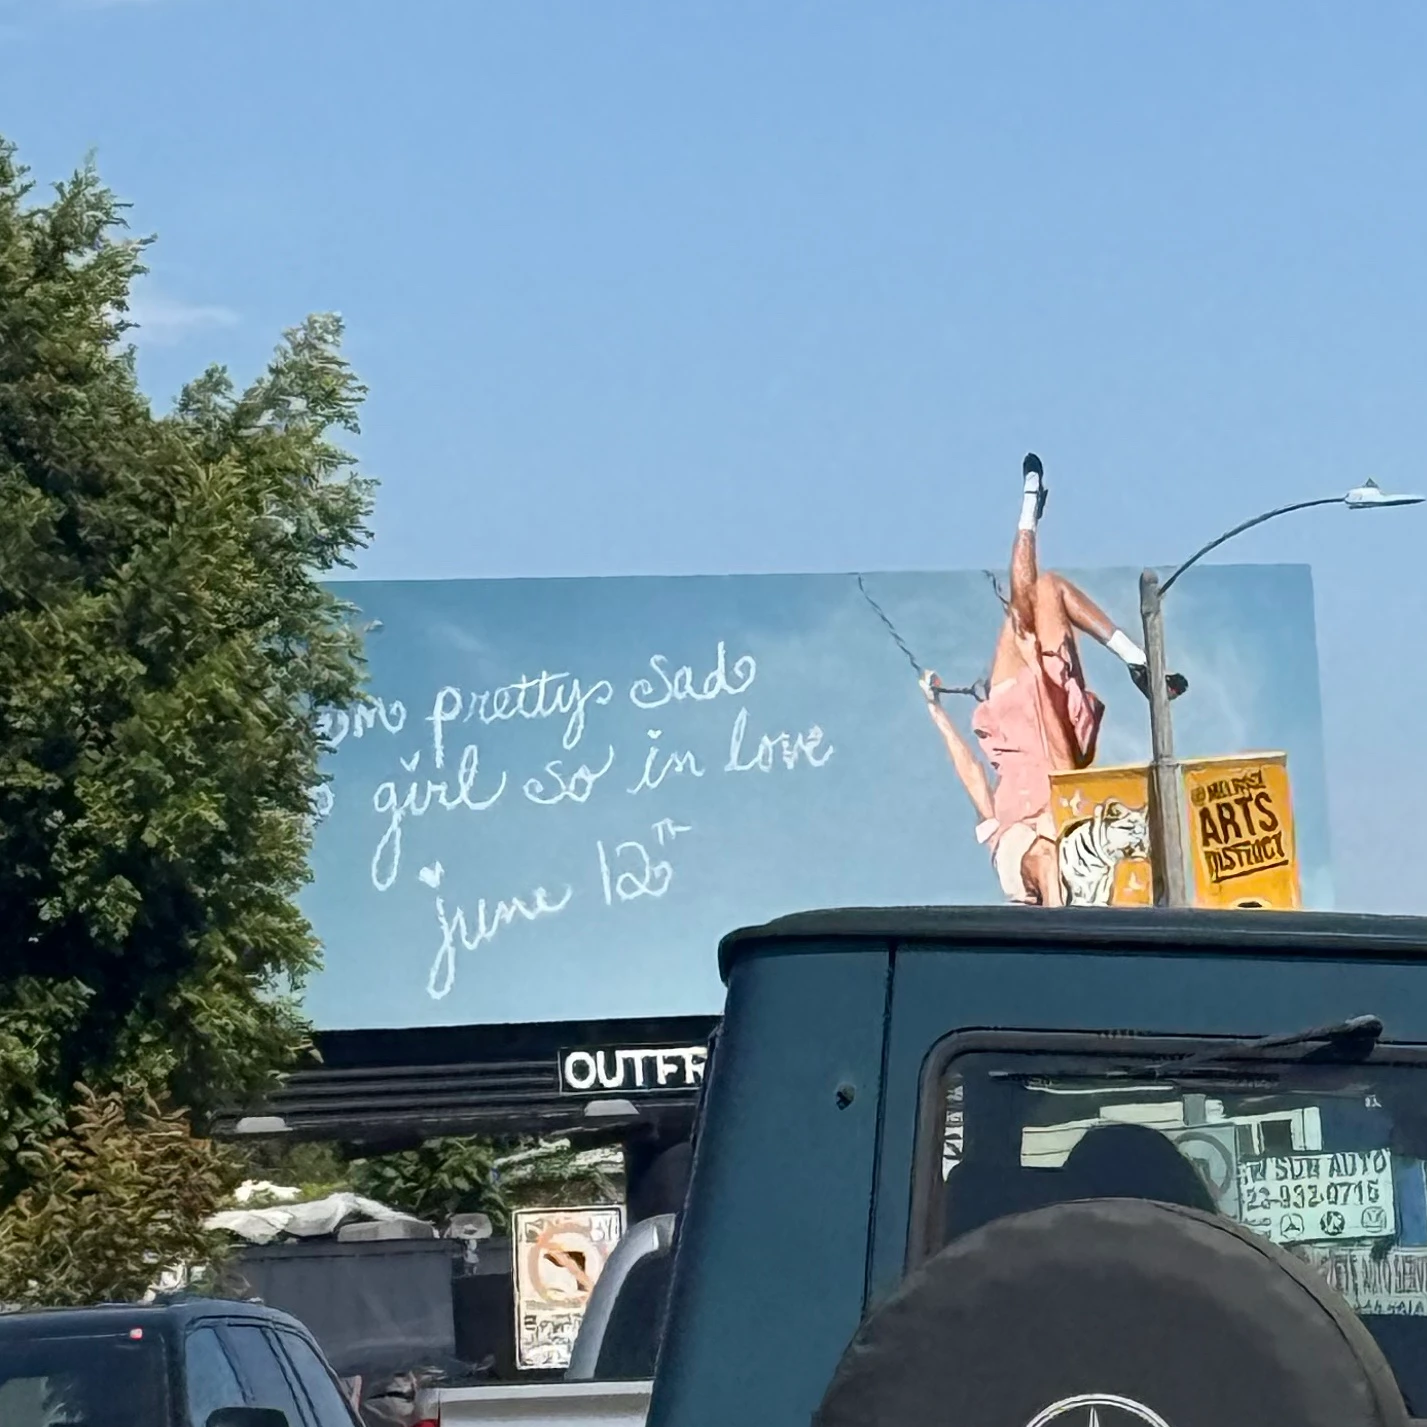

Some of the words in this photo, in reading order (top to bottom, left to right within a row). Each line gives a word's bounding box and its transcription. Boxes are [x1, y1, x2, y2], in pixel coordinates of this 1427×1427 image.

[426, 671, 614, 768] pretty
[371, 744, 508, 891] girl
[625, 729, 705, 795] in
[724, 706, 836, 774] love
[1198, 791, 1279, 848] ARTS
[418, 860, 574, 1001] june
